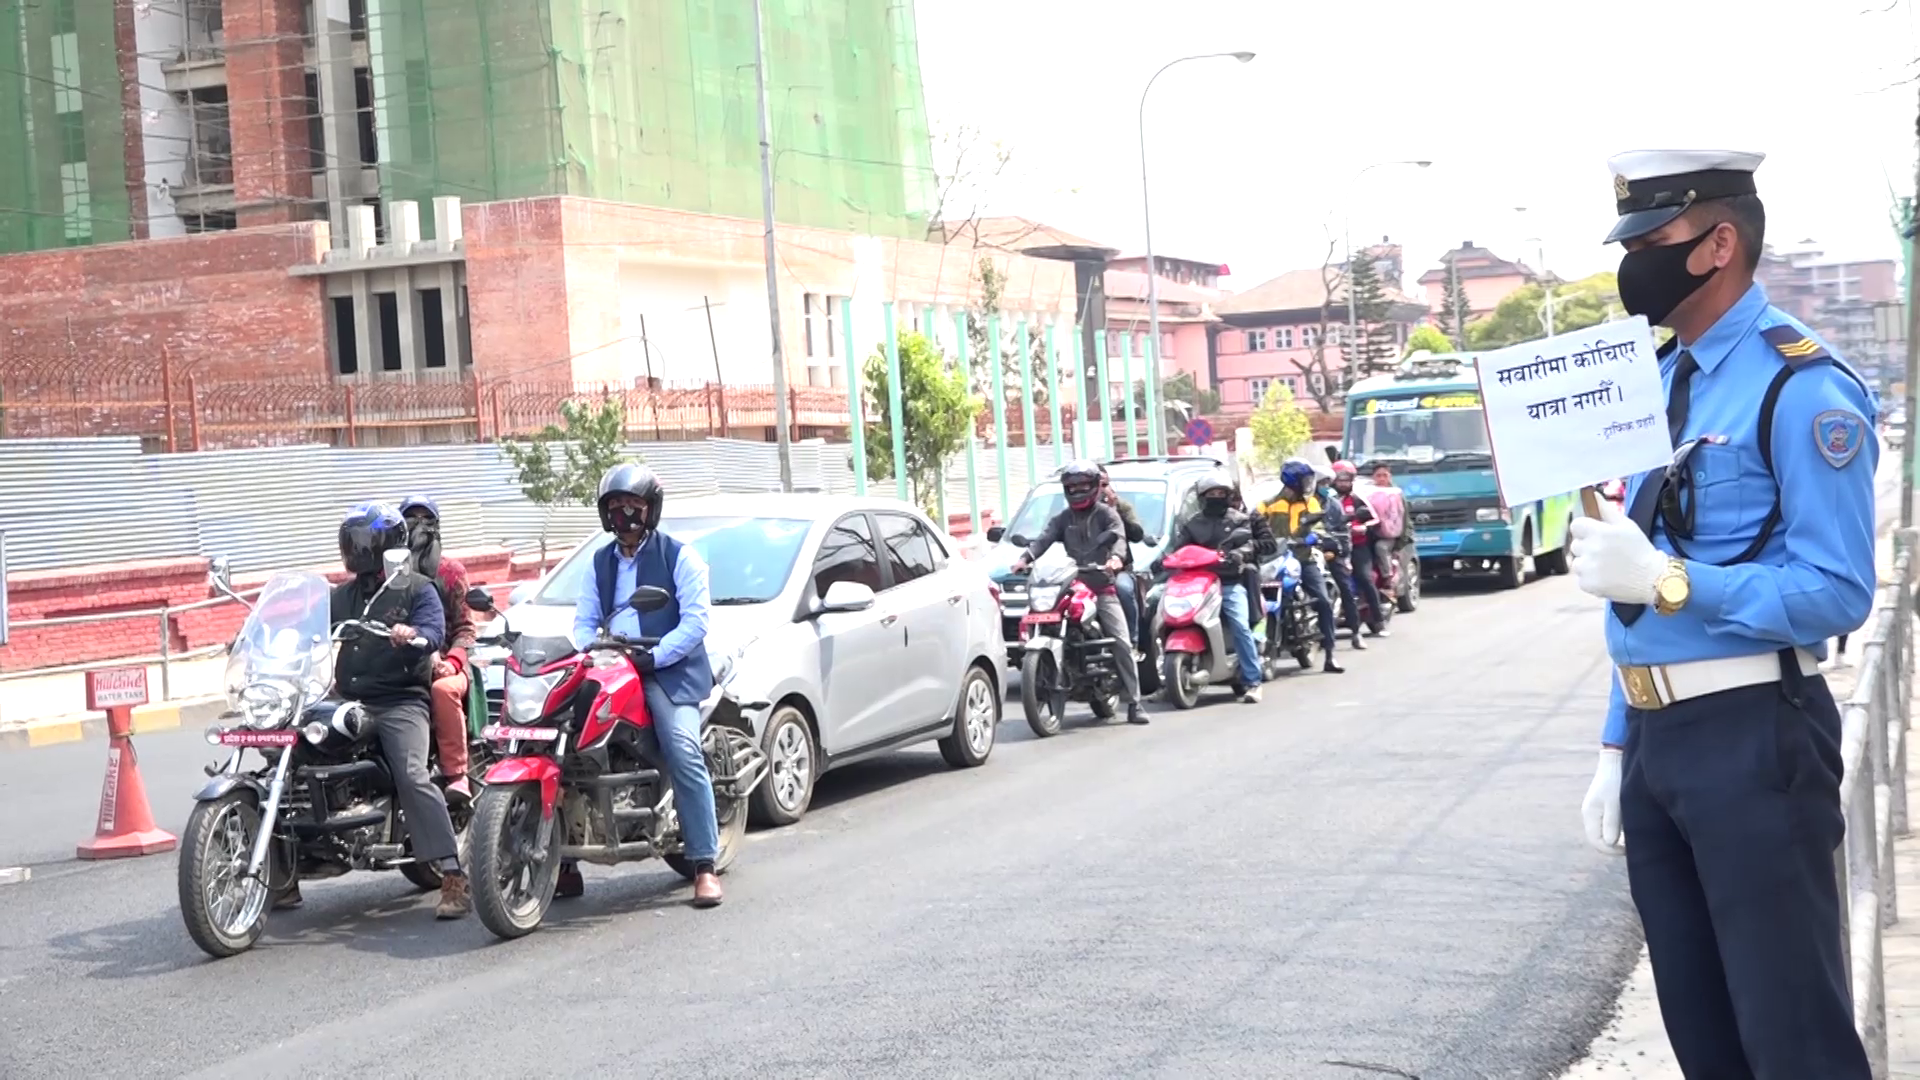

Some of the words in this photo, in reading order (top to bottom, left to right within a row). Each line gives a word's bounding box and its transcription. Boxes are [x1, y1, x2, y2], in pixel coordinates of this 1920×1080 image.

[1496, 355, 1568, 386] सवारीमा
[1572, 339, 1639, 367] कोचिएर
[1527, 397, 1567, 420] यात्रा
[98, 692, 122, 702] WATER
[124, 690, 144, 699] TANK
